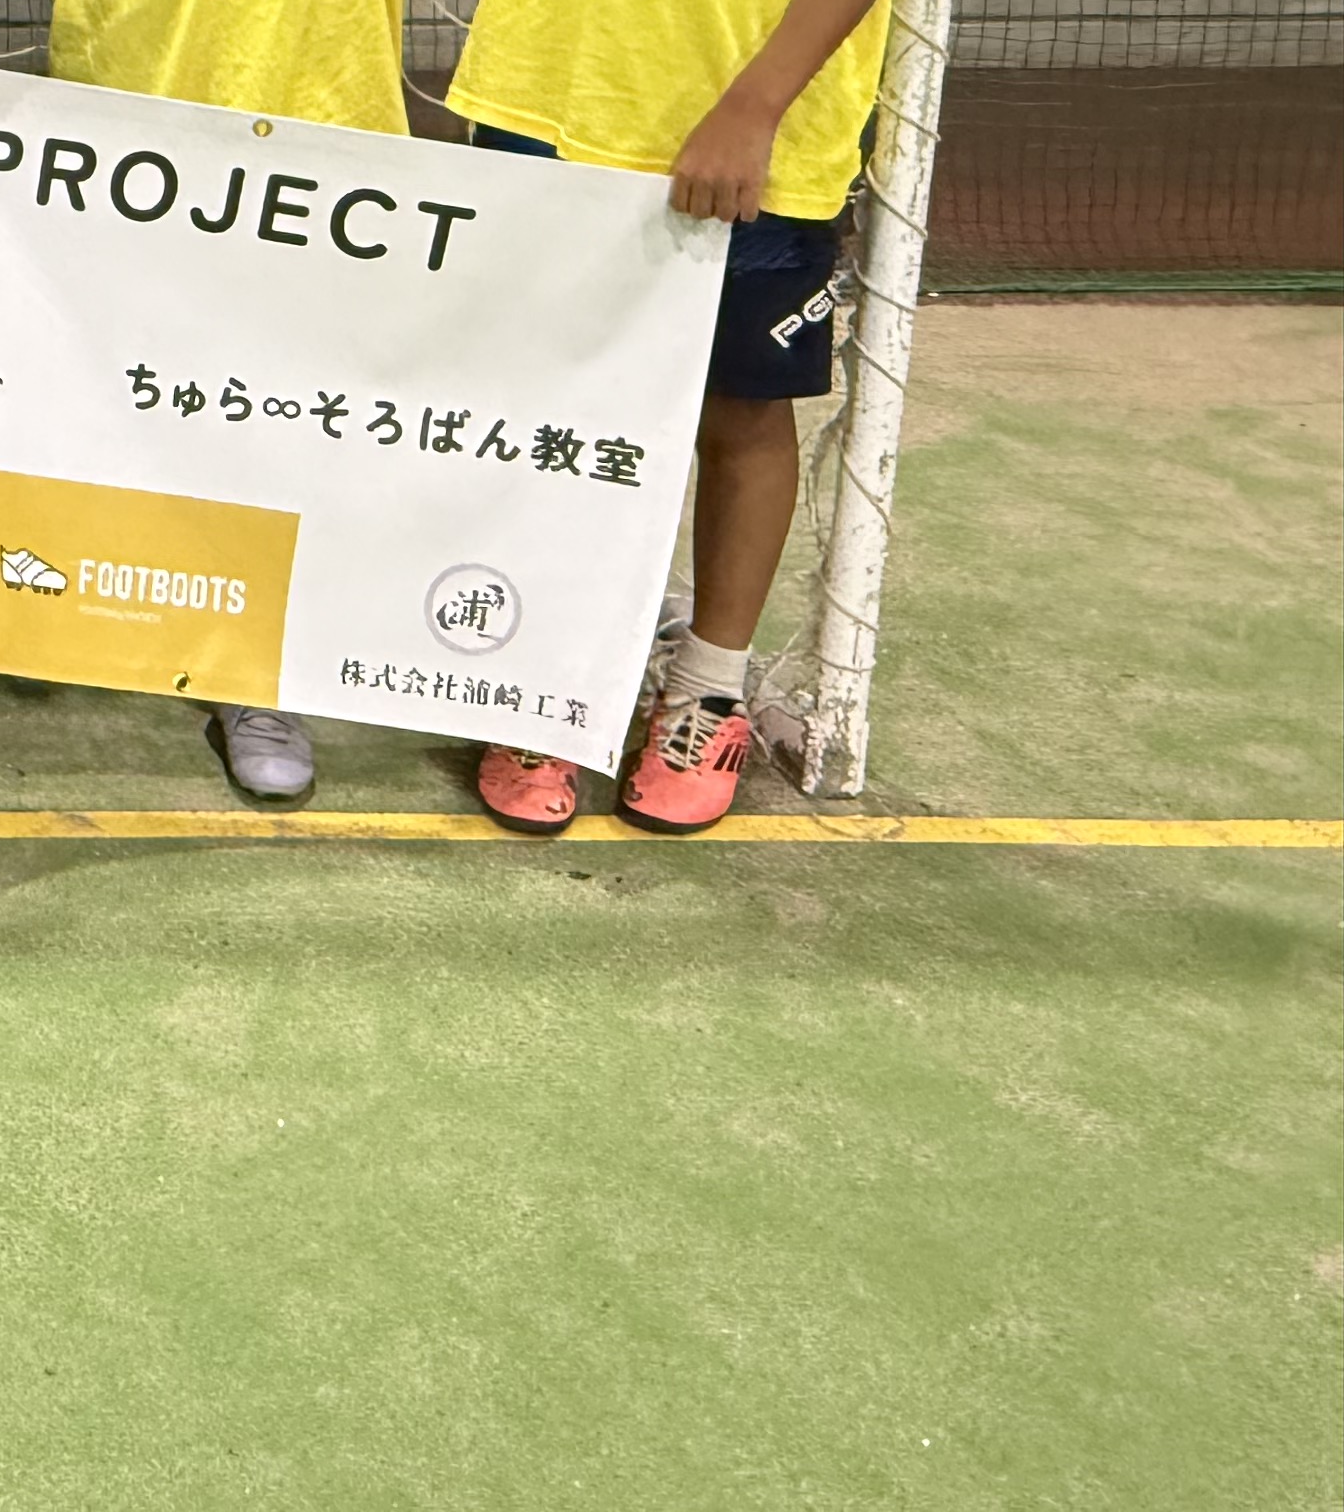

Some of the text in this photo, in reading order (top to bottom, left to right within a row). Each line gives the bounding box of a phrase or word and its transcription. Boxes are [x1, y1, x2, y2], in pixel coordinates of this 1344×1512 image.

[125, 363, 645, 487] ちゅら∞そろばん教室
[78, 558, 247, 615] FOOTBOOTS
